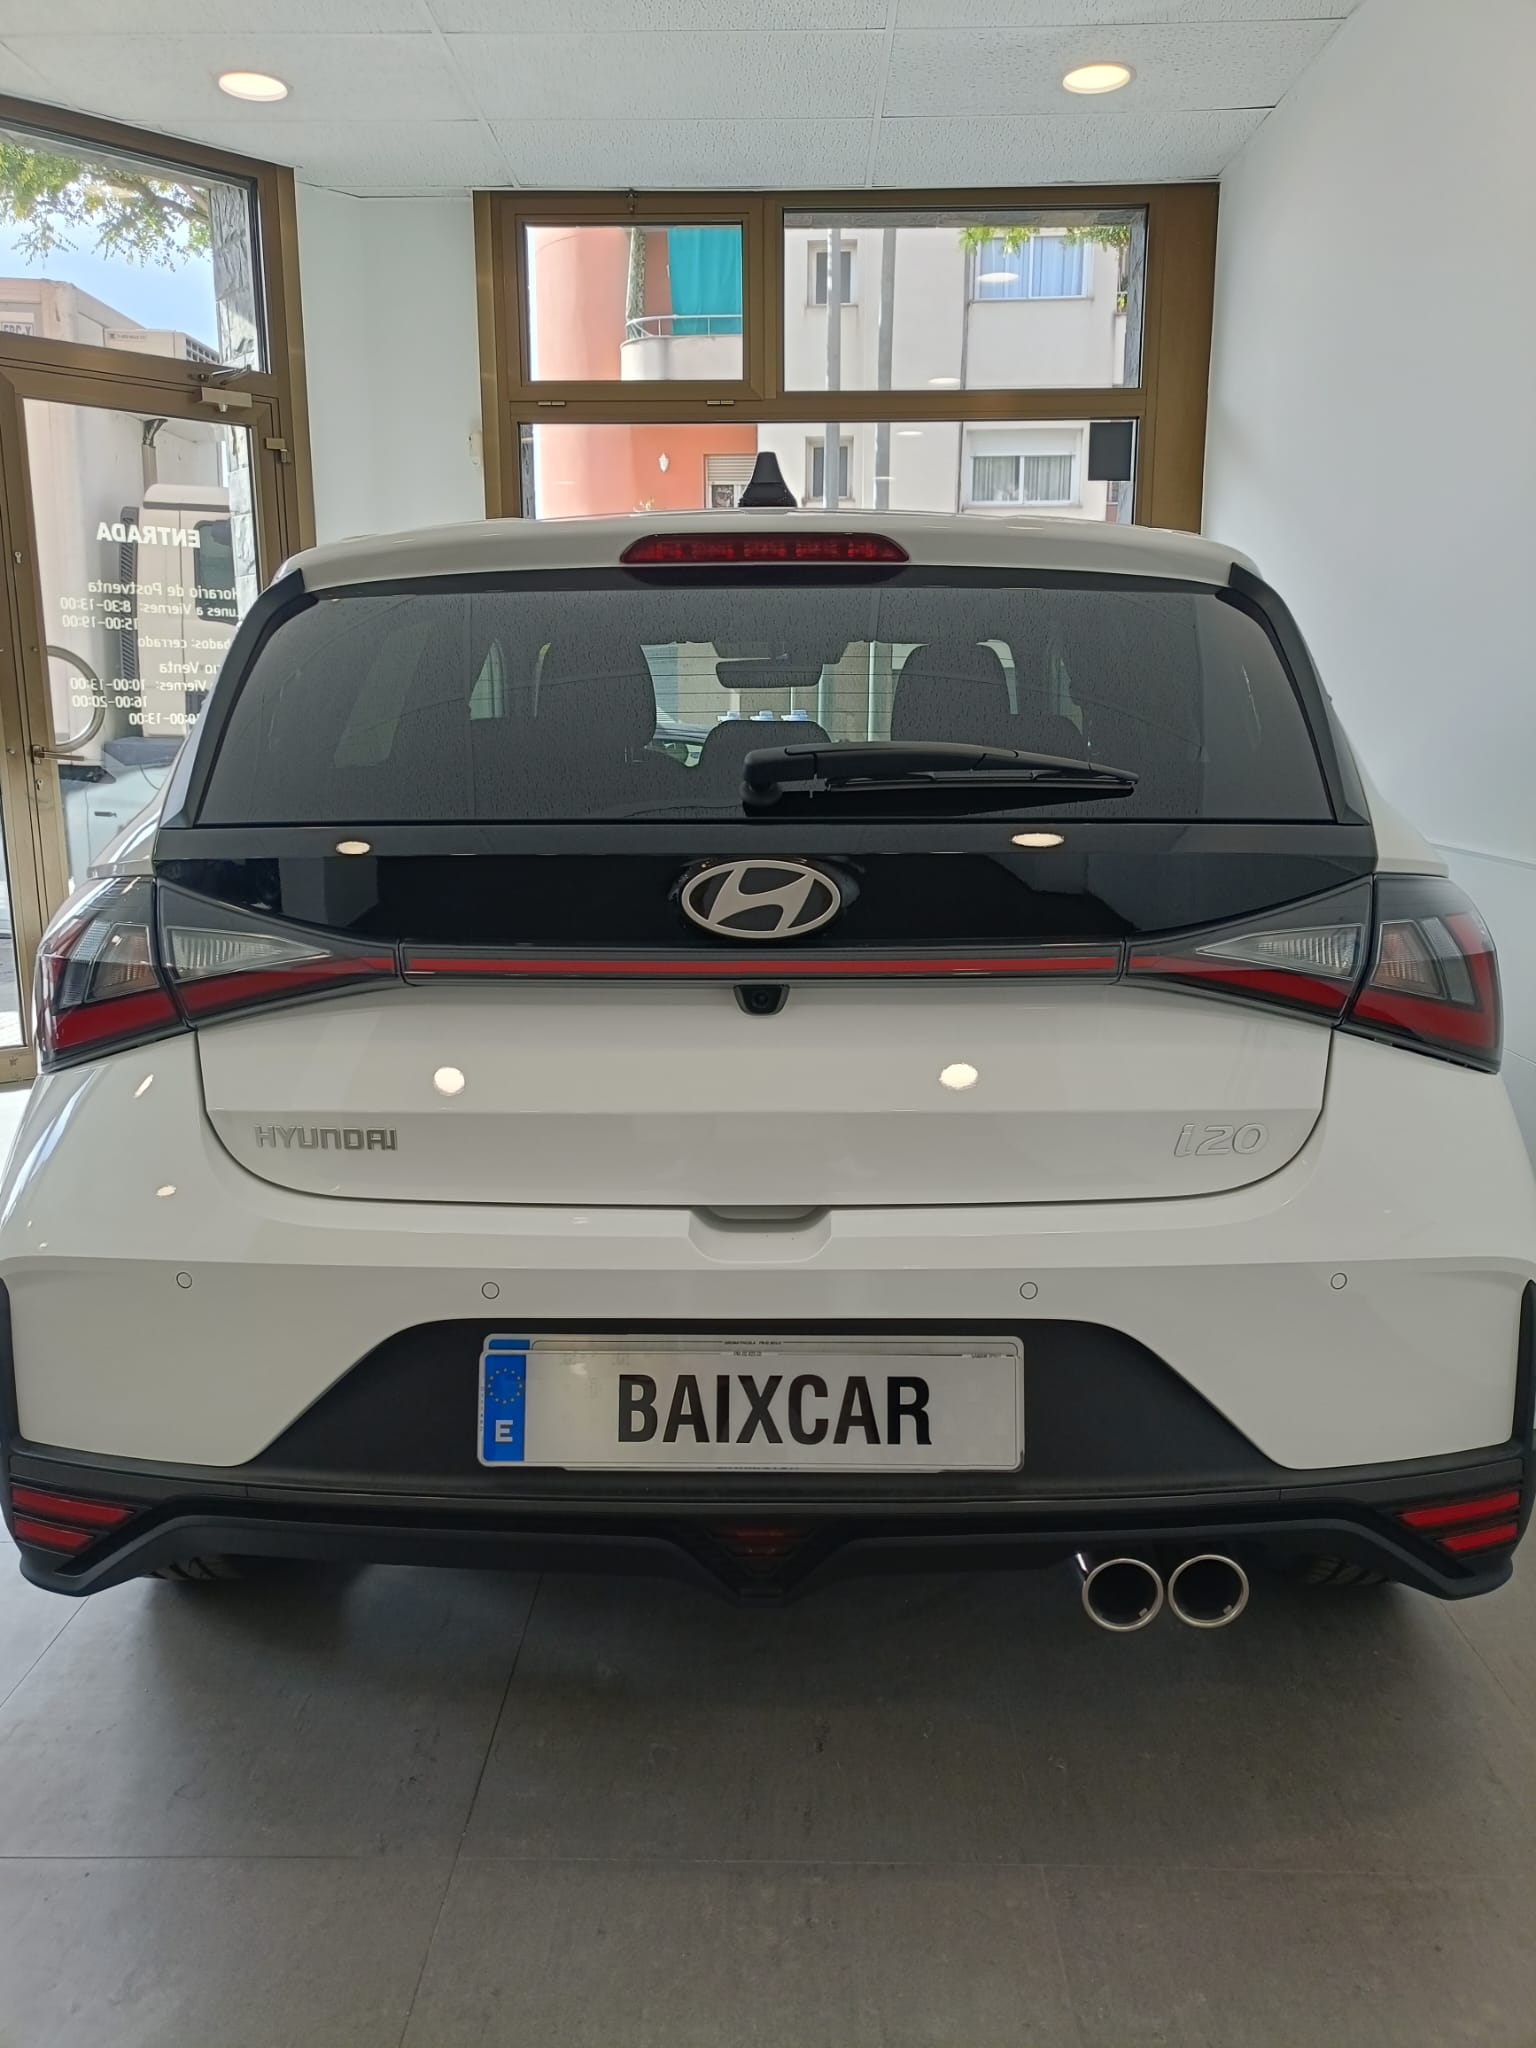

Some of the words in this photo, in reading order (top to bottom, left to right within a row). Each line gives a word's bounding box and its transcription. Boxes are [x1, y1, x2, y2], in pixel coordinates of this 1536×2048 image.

[254, 1125, 398, 1151] HYUNDAI
[1174, 1123, 1269, 1157] i20
[617, 1373, 933, 1446] BAIXCAR
[495, 1419, 514, 1443] E
